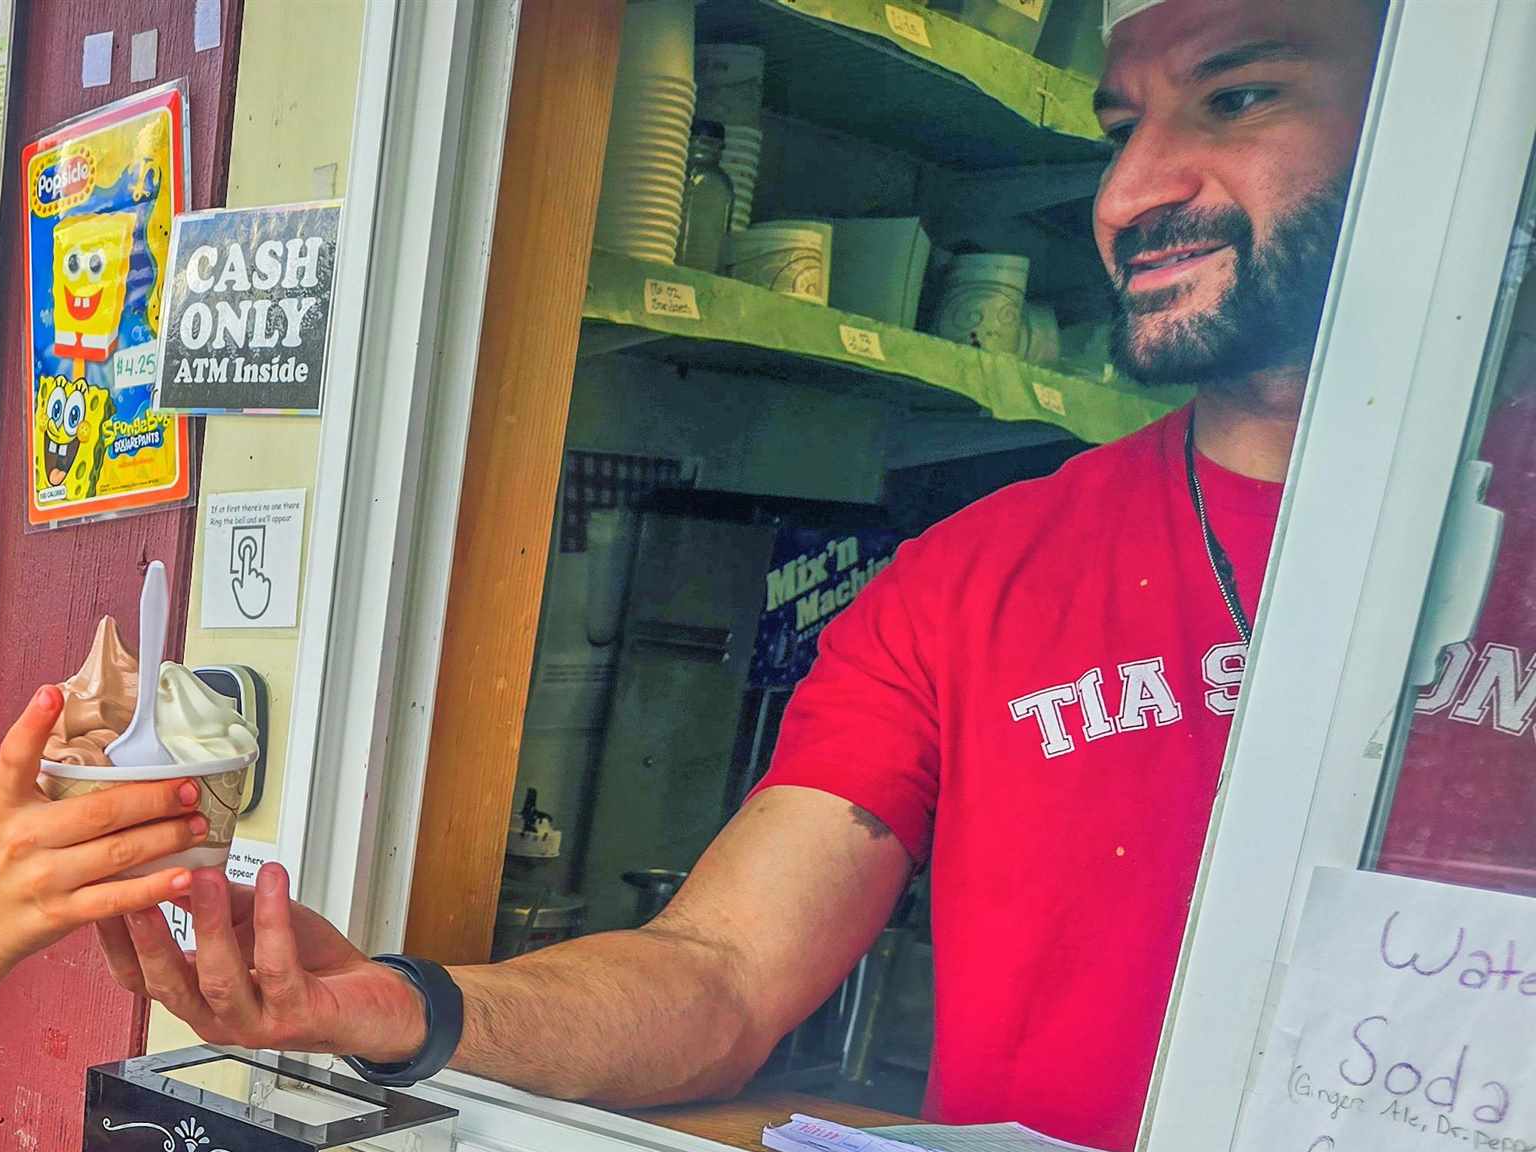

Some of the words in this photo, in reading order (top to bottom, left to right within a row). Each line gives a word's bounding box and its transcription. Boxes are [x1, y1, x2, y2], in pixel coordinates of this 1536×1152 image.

[36, 160, 90, 200] Popsicle
[185, 236, 324, 294] CASH
[179, 297, 316, 350] ONLY
[116, 353, 156, 377] $4.25
[174, 357, 231, 384] ATM
[232, 356, 309, 384] Inside
[113, 431, 161, 453] SQUAREPANTS
[766, 536, 859, 612] Mix'n
[1007, 655, 1183, 760] TIA
[1201, 641, 1249, 716] S
[228, 868, 254, 879] appear
[1380, 910, 1536, 997] Wate
[1339, 1015, 1511, 1124] Soda
